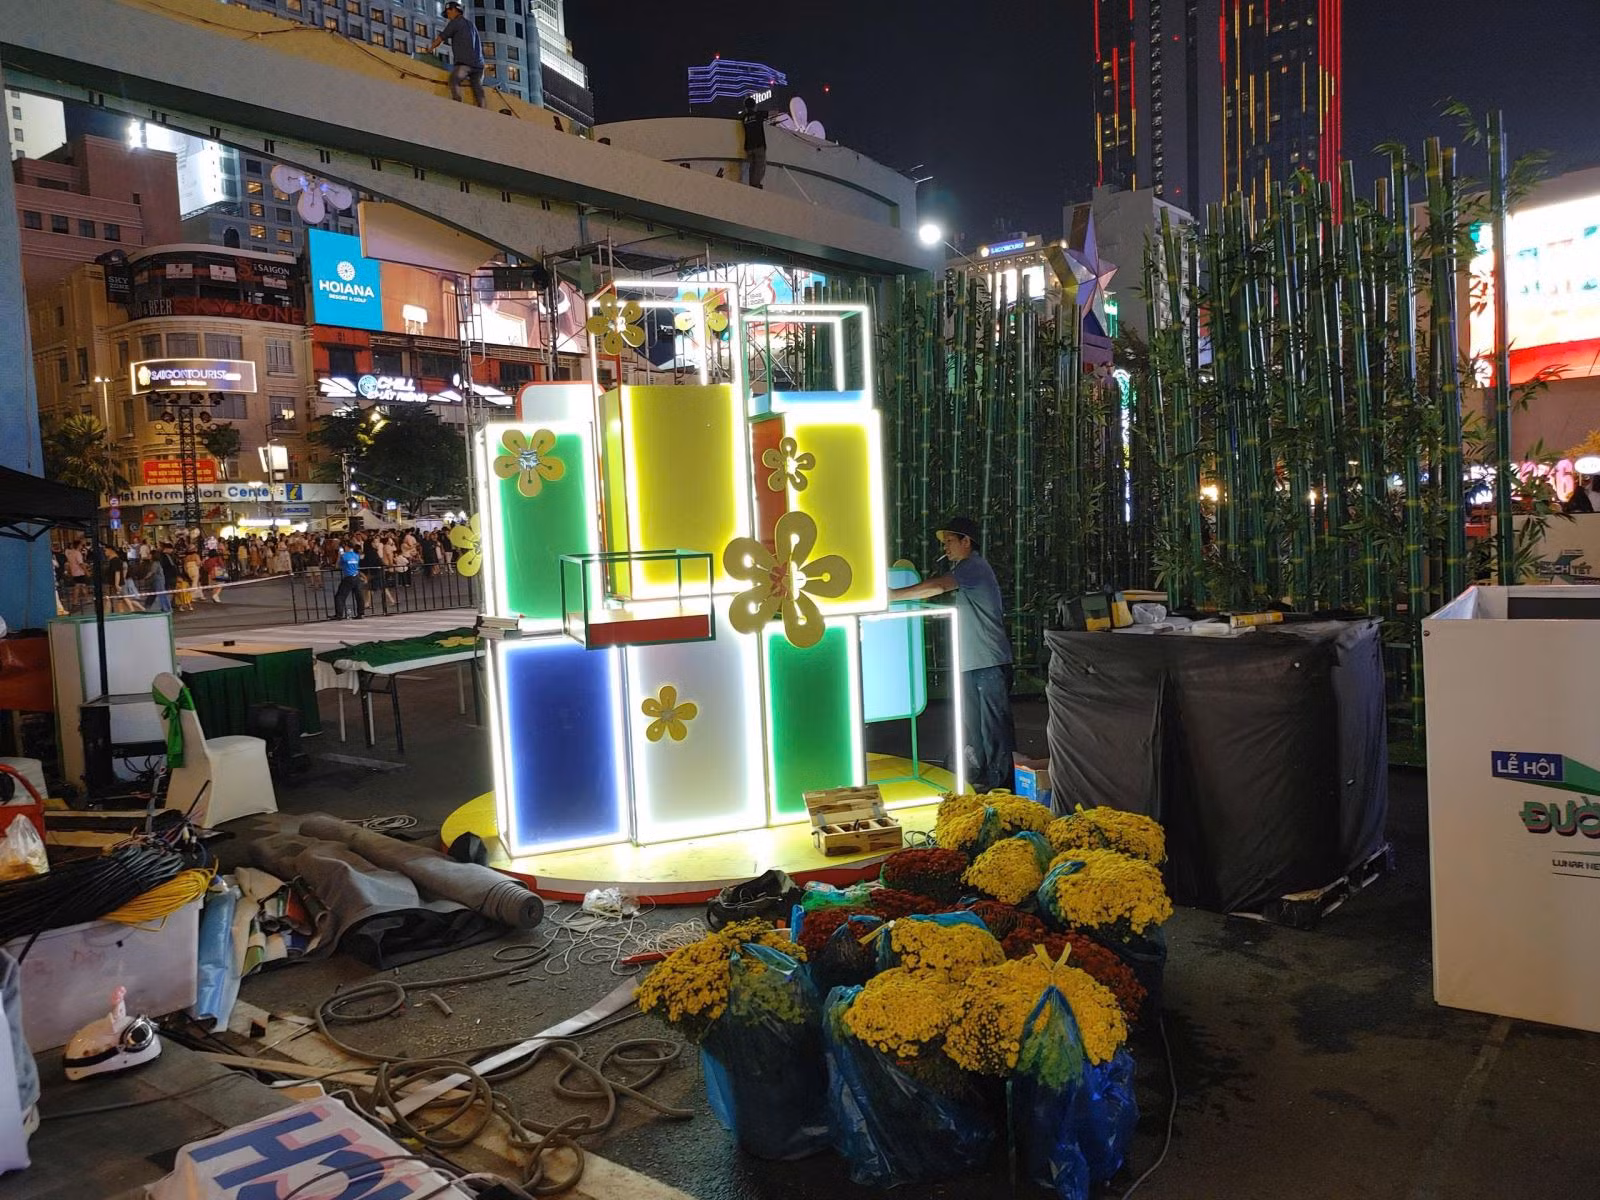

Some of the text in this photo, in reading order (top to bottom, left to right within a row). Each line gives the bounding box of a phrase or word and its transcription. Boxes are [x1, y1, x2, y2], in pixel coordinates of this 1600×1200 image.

[258, 263, 290, 276] SAIGON
[108, 275, 129, 284] SKY
[319, 279, 375, 298] HOIANA
[149, 298, 173, 316] BEER
[240, 302, 305, 324] ZONE
[151, 369, 227, 380] SAIGONTOURIST
[377, 376, 416, 391] CHILL
[138, 488, 222, 501] Informion
[228, 486, 273, 497] Cente
[1497, 753, 1556, 778] LỄ HỘI
[1552, 859, 1584, 869] LUNAR
